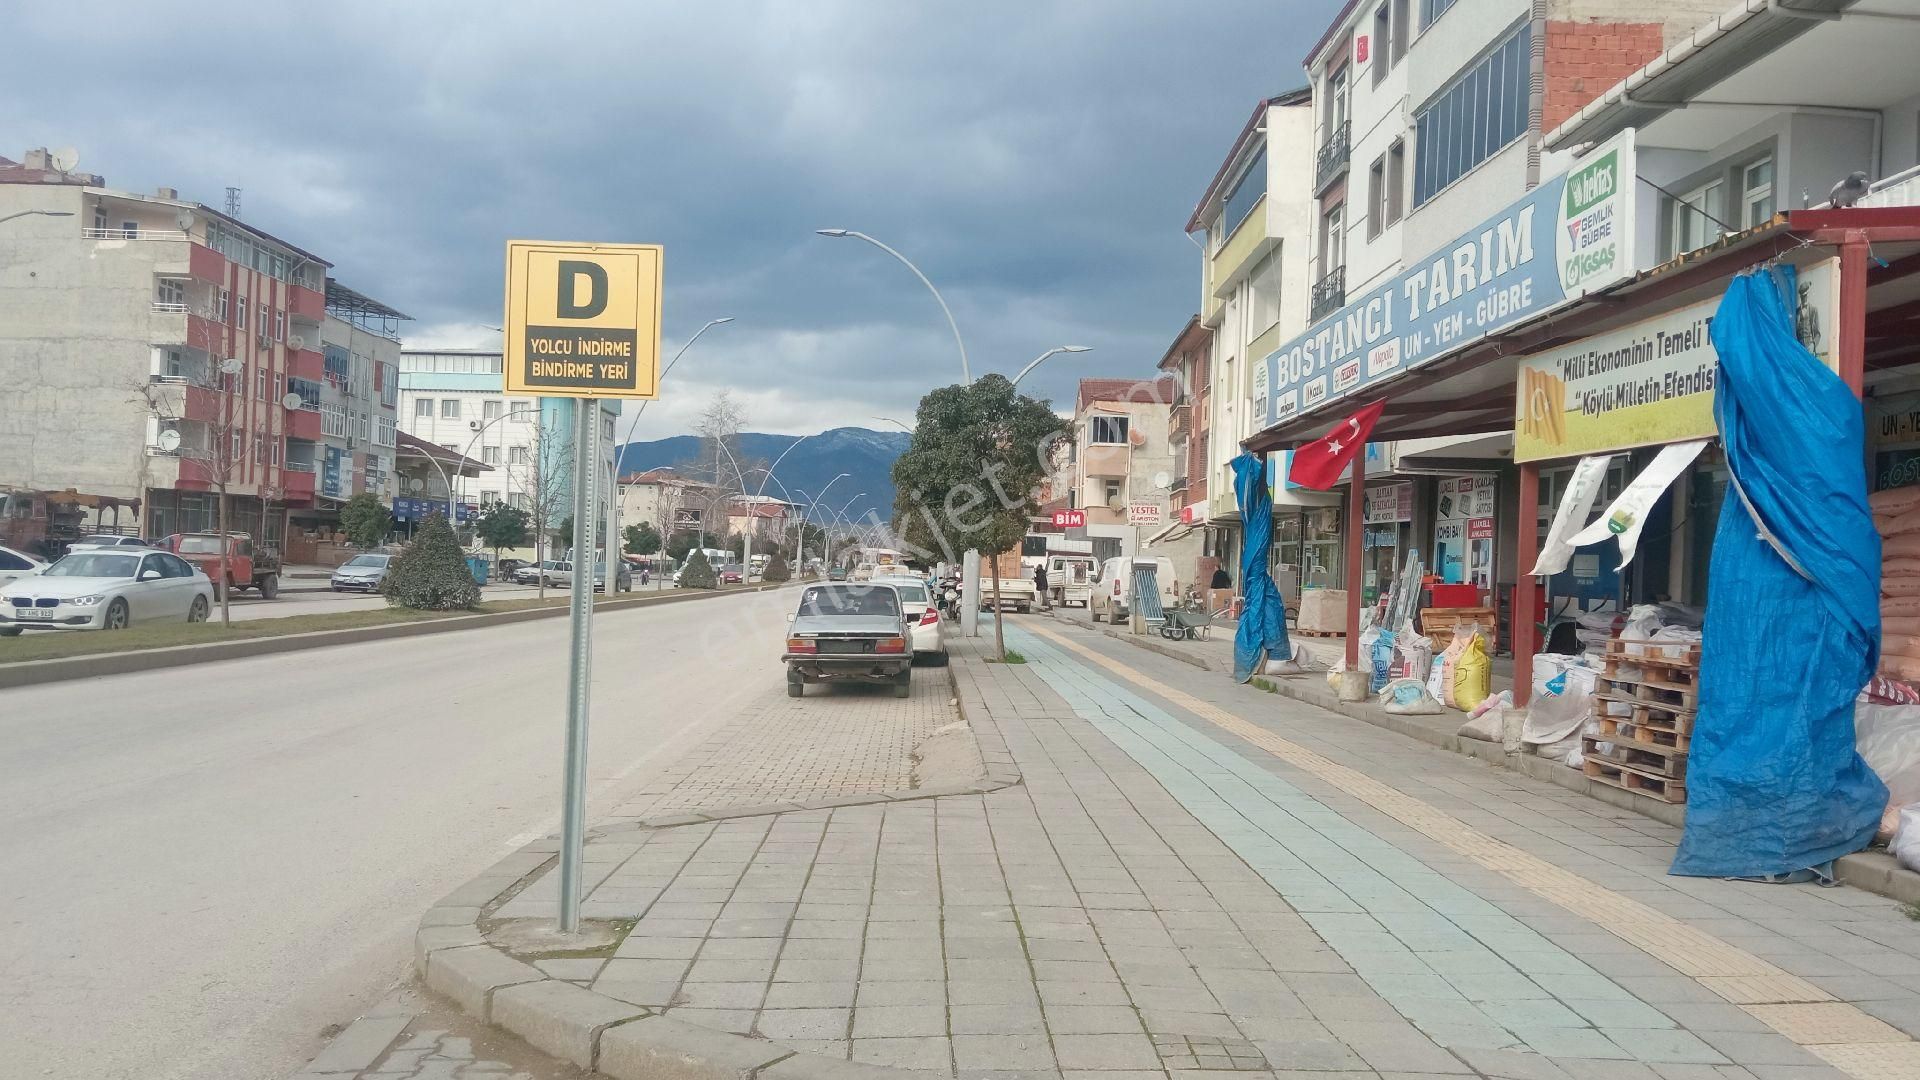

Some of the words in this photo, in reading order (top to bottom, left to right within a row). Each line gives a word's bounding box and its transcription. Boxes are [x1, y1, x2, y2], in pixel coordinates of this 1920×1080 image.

[1581, 203, 1614, 231] GEMLİK
[1581, 222, 1612, 249] GÜBRE
[557, 260, 608, 319] D
[1277, 289, 1393, 391] BOSTANCI
[1404, 202, 1536, 322] TARIM
[1404, 331, 1422, 360] UN
[1433, 311, 1463, 346] YEM
[1476, 277, 1532, 327] GÜBRE
[531, 338, 572, 355] YOLCU
[578, 337, 631, 357] İNDİRME
[1588, 337, 1653, 376] Ekonominin
[1657, 322, 1702, 359] Temeli
[532, 359, 594, 379] BİNDİRME
[599, 361, 629, 380] YERİ
[1616, 377, 1660, 410] Milletin
[1882, 415, 1898, 437] UN
[1056, 511, 1082, 525] BİM
[1130, 506, 1159, 515] VESTEL
